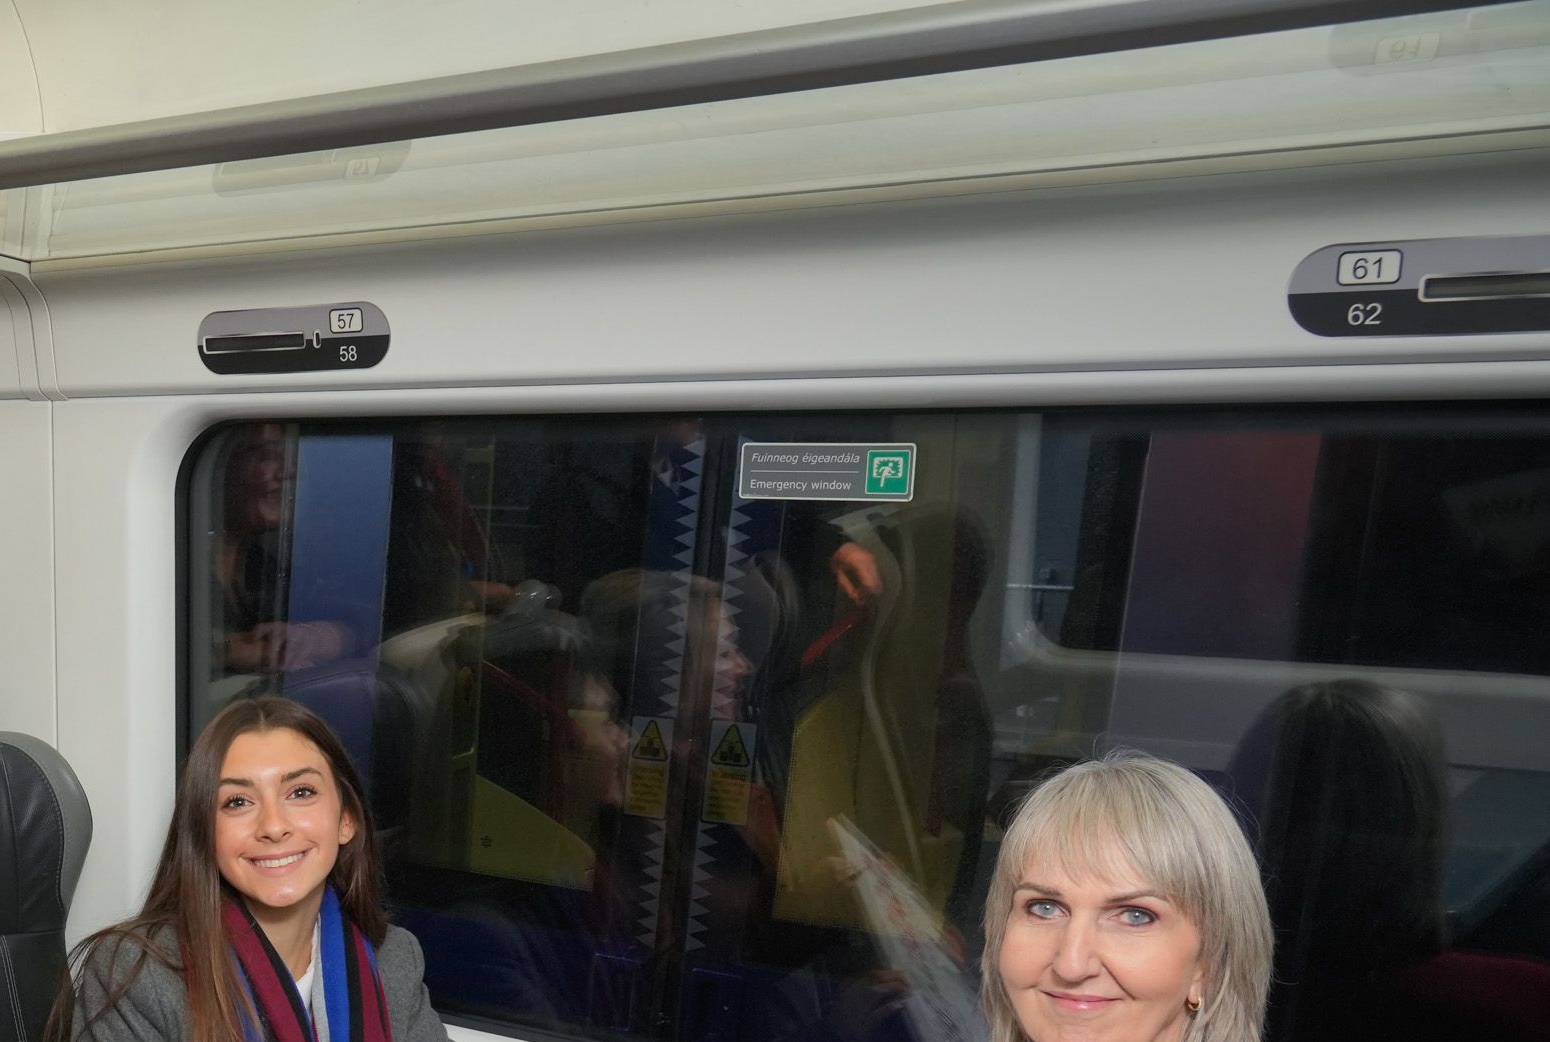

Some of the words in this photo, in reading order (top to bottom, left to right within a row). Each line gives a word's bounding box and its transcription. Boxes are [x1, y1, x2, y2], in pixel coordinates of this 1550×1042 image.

[1351, 256, 1384, 280] 61
[337, 313, 355, 330] 57
[1347, 303, 1382, 325] 62
[339, 345, 358, 362] 58
[751, 452, 799, 464] Fuinneog
[801, 452, 861, 465] éigeandála
[750, 479, 808, 491] Emergency
[811, 479, 852, 490] window
